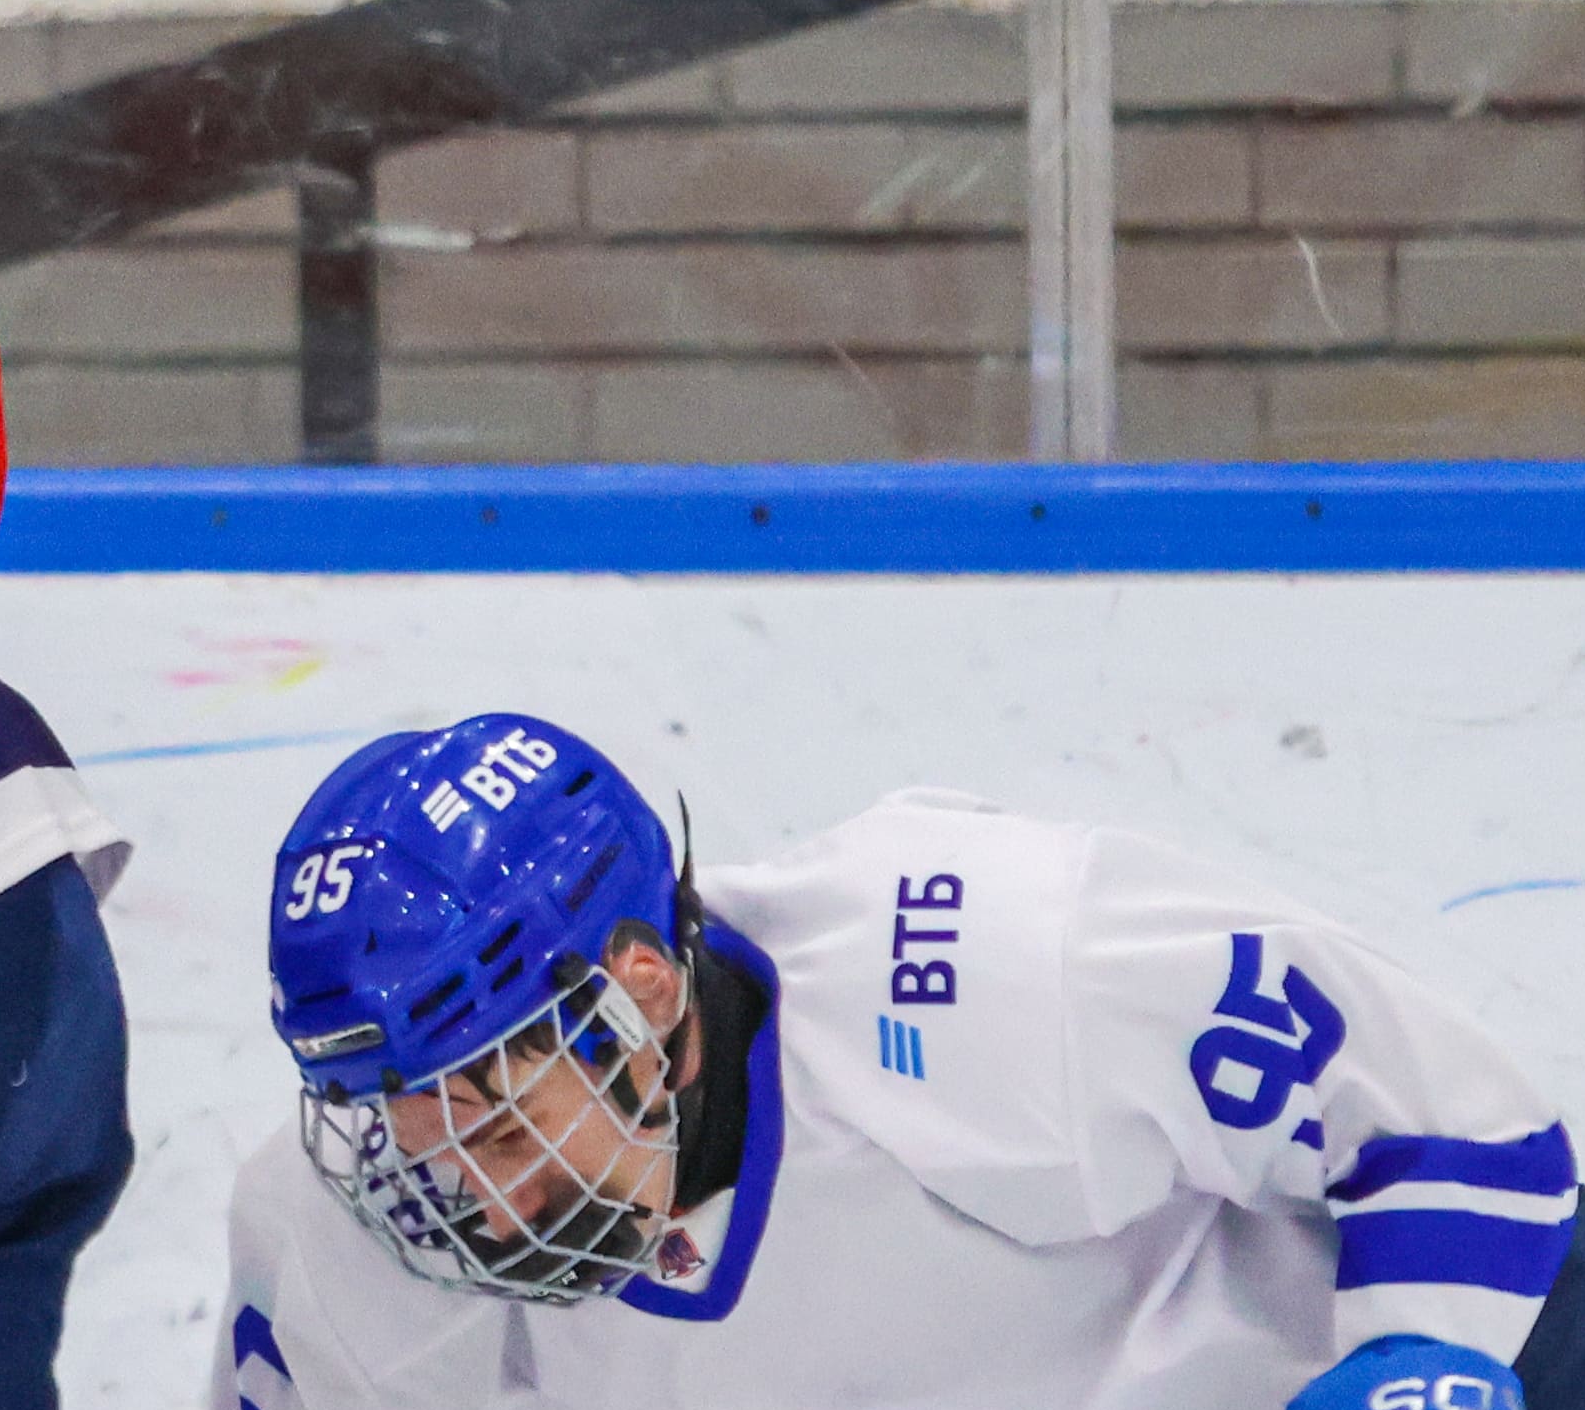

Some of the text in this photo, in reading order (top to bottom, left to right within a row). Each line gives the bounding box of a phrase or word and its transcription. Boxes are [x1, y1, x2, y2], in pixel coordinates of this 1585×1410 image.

[460, 727, 558, 812] ВТБ
[285, 844, 365, 921] 95
[890, 872, 965, 1005] ВТБ
[1189, 932, 1347, 1151] 95
